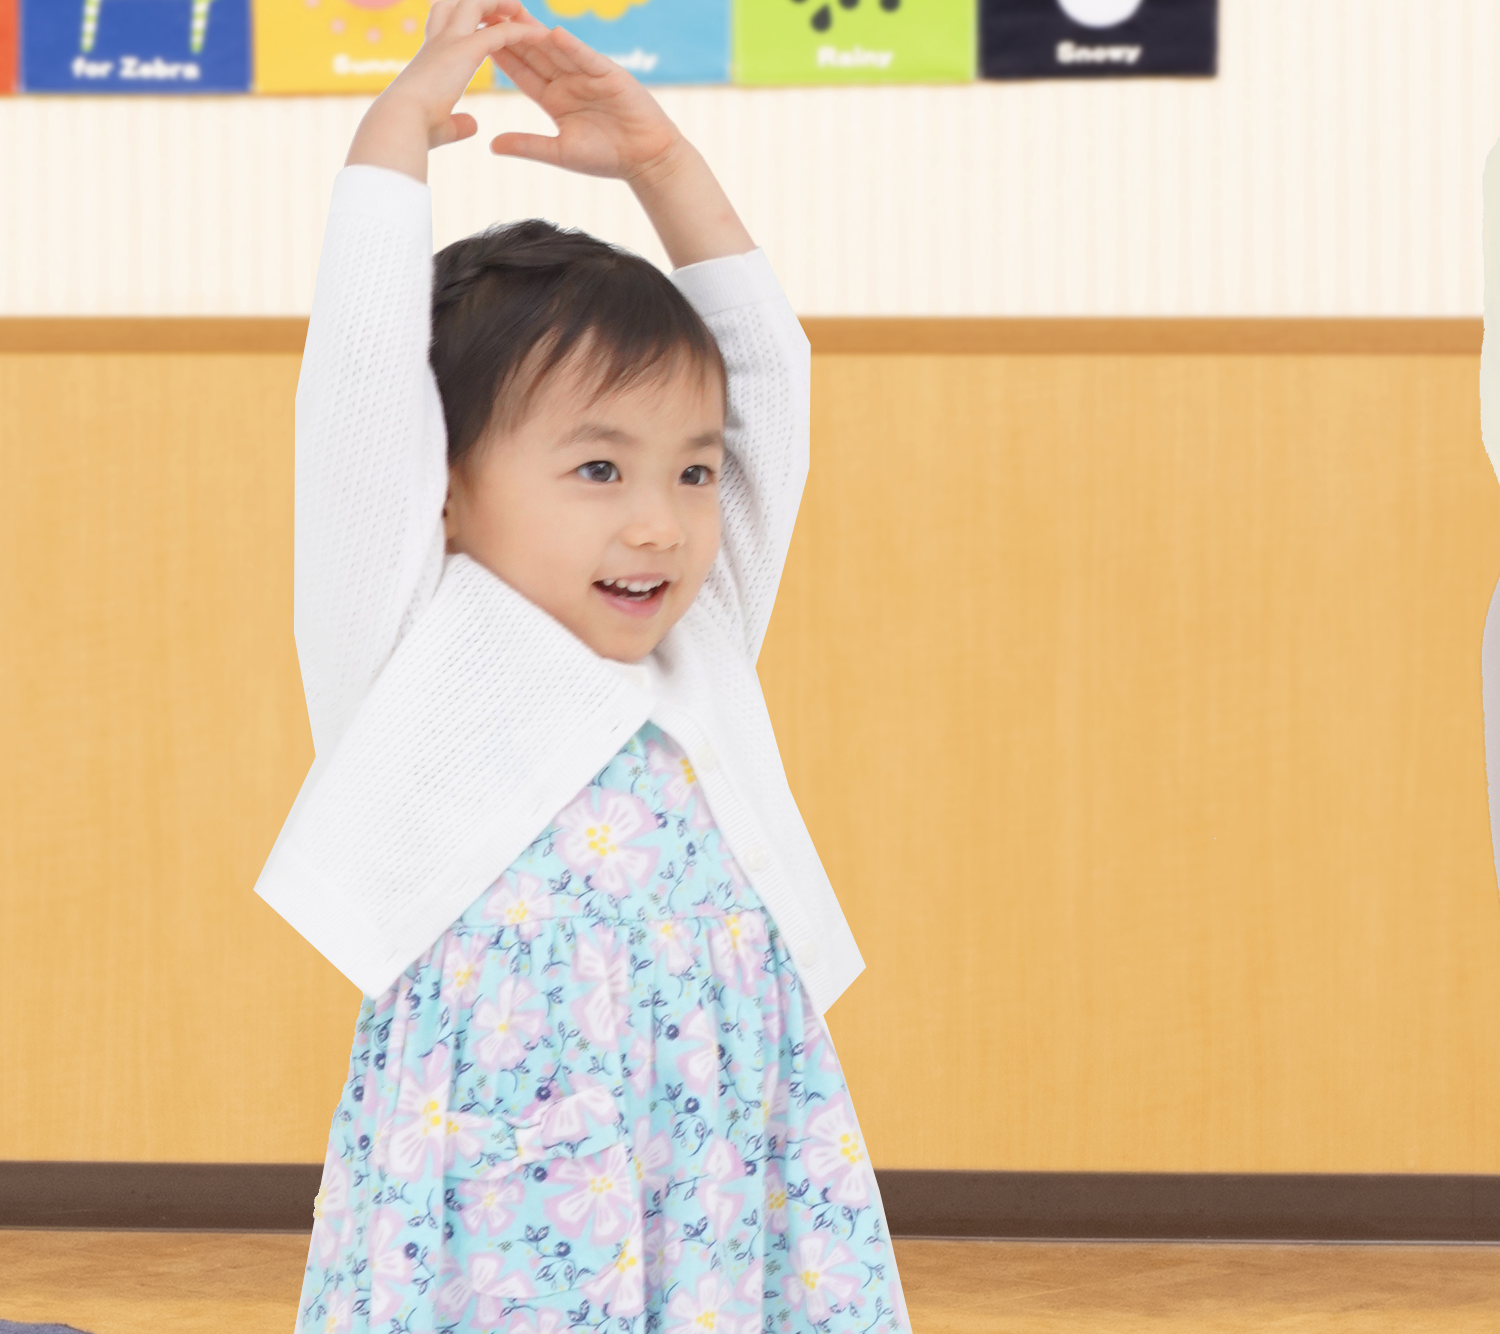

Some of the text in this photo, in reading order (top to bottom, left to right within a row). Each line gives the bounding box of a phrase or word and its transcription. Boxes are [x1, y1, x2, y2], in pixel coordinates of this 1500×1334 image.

[332, 53, 410, 75] Sunn
[815, 45, 895, 70] Rainy
[1055, 41, 1142, 65] Snowy
[71, 56, 201, 81] for Zebra
